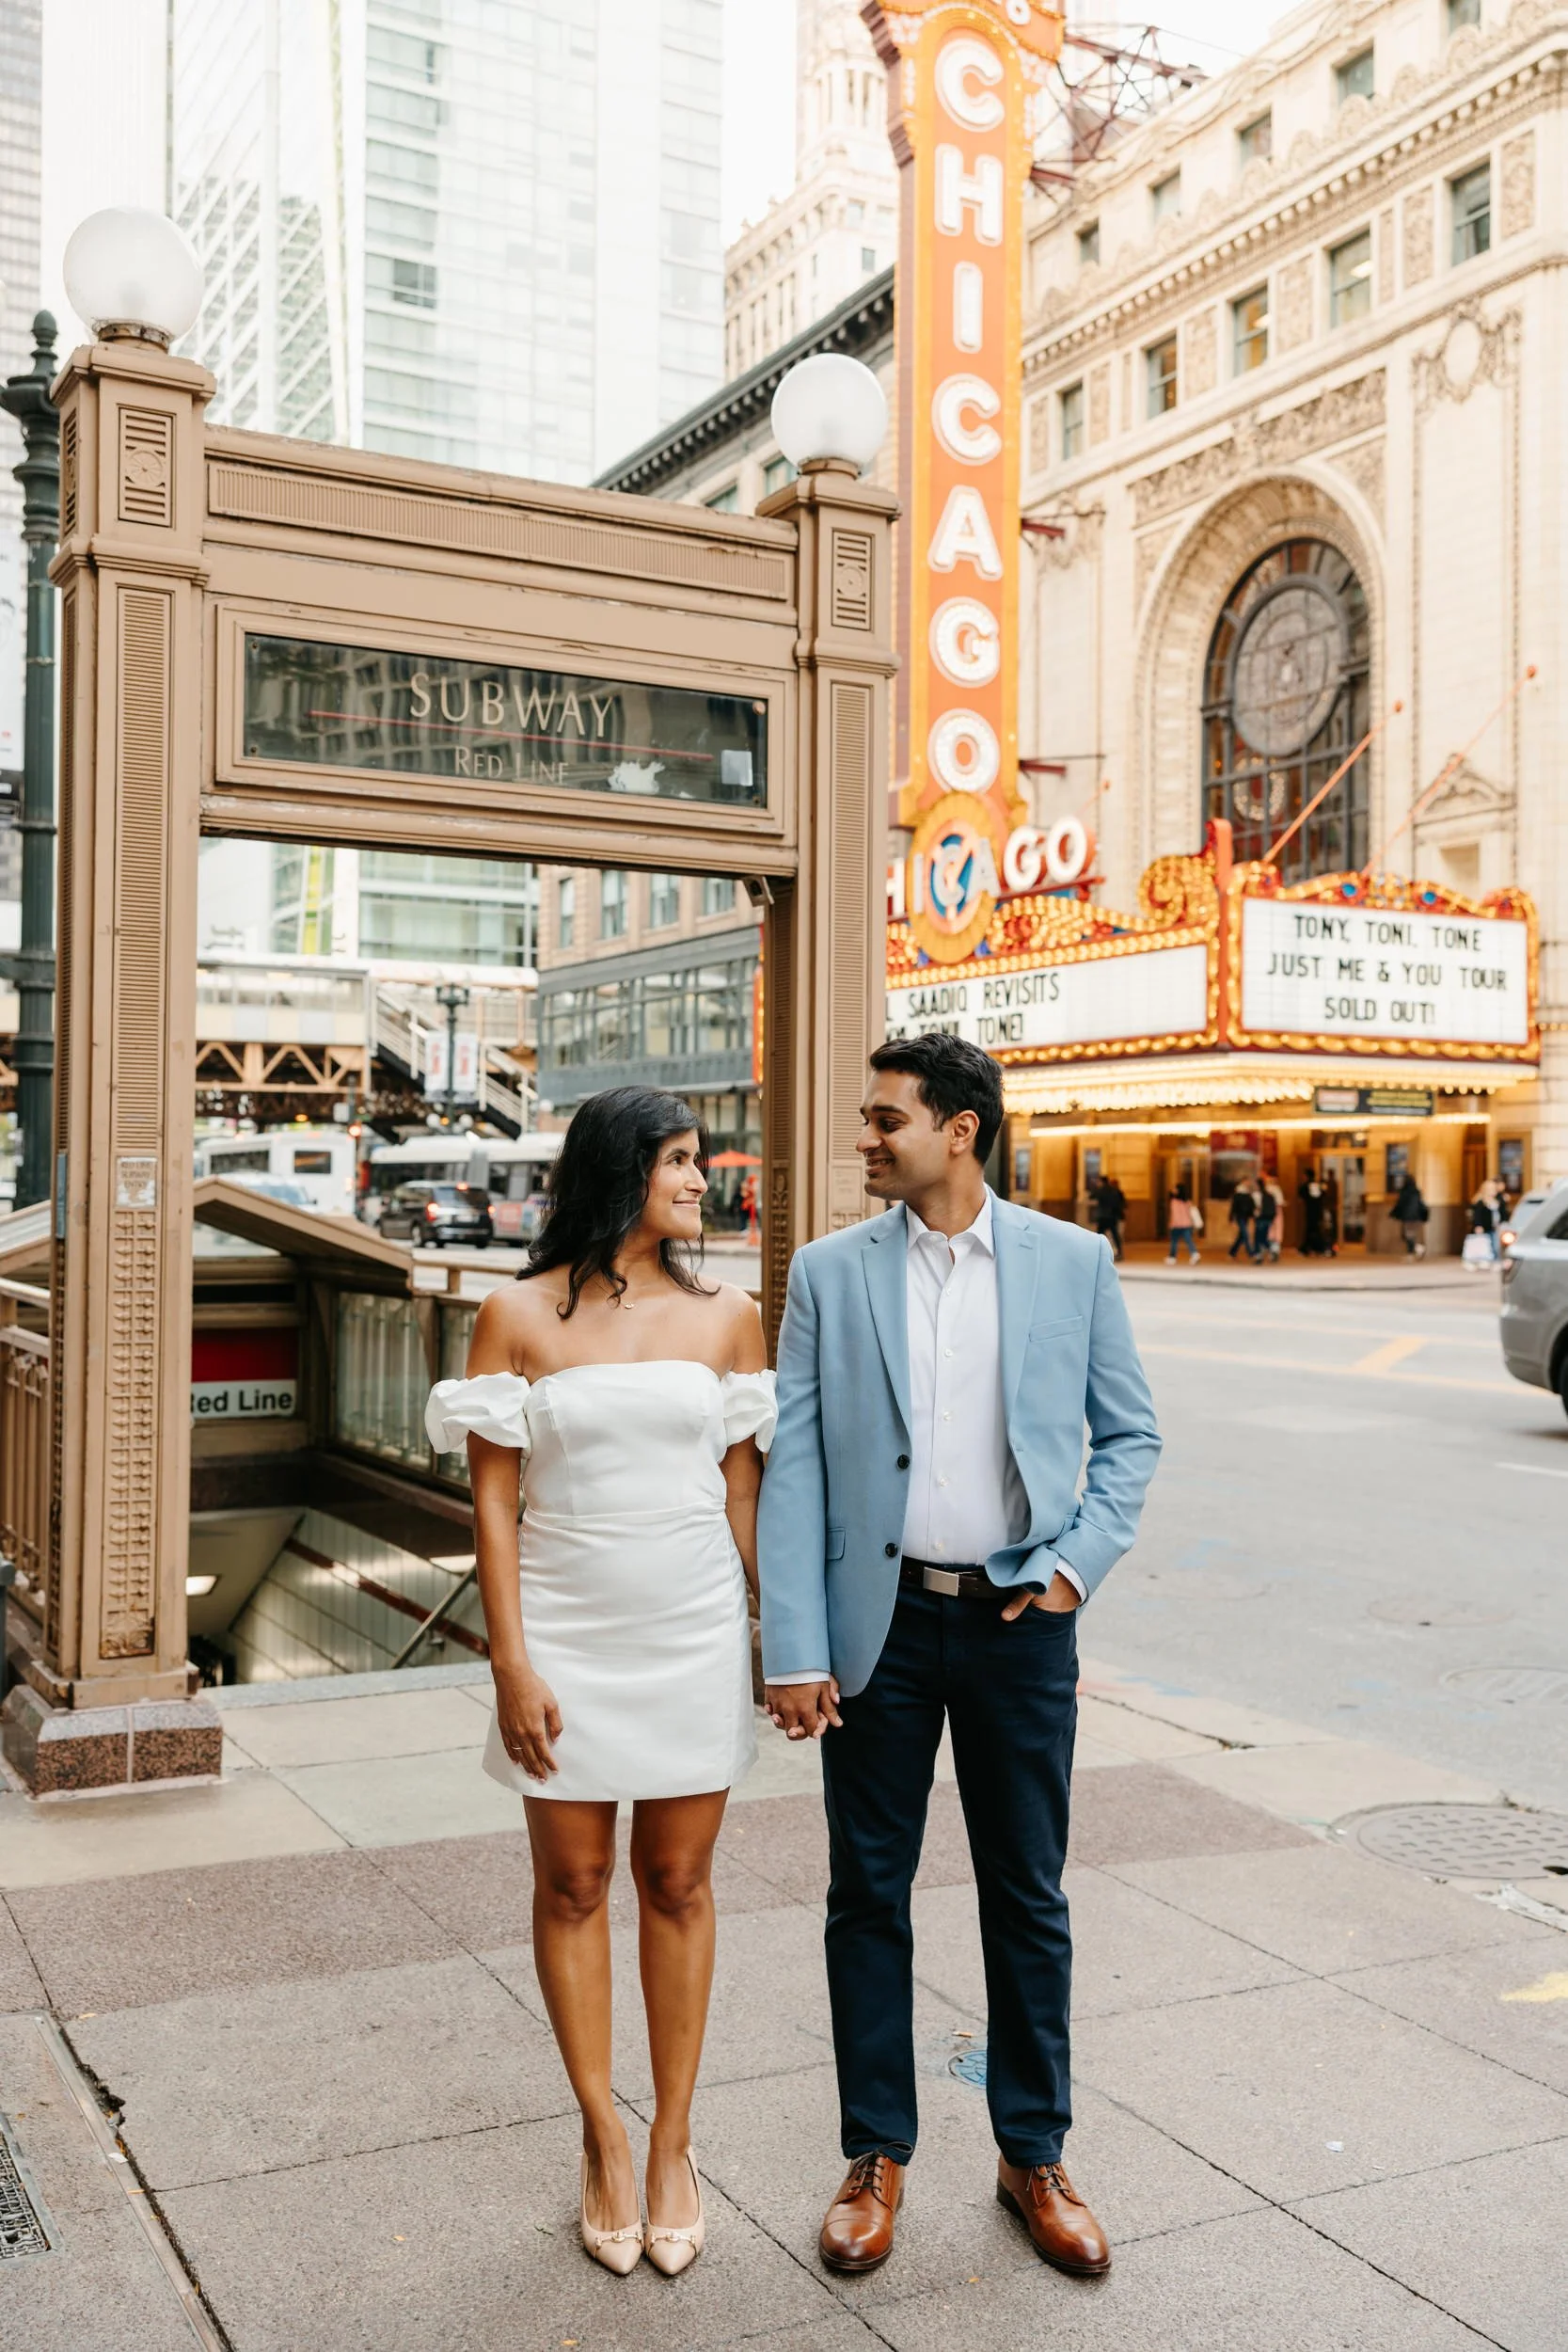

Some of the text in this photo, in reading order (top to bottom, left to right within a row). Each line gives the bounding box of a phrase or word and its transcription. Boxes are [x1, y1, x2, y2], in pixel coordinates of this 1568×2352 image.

[929, 38, 1006, 796] CHICAGO
[410, 672, 612, 738] SUBWAY
[454, 746, 568, 784] RED LINE
[886, 817, 1088, 918] HICAGO
[1432, 927, 1481, 951] TONE
[1267, 953, 1507, 990] JUST ME & YOU TOUR
[984, 973, 1059, 1009] REVISITS
[1324, 997, 1376, 1021] SOLD
[190, 1390, 293, 1413] ed Line
